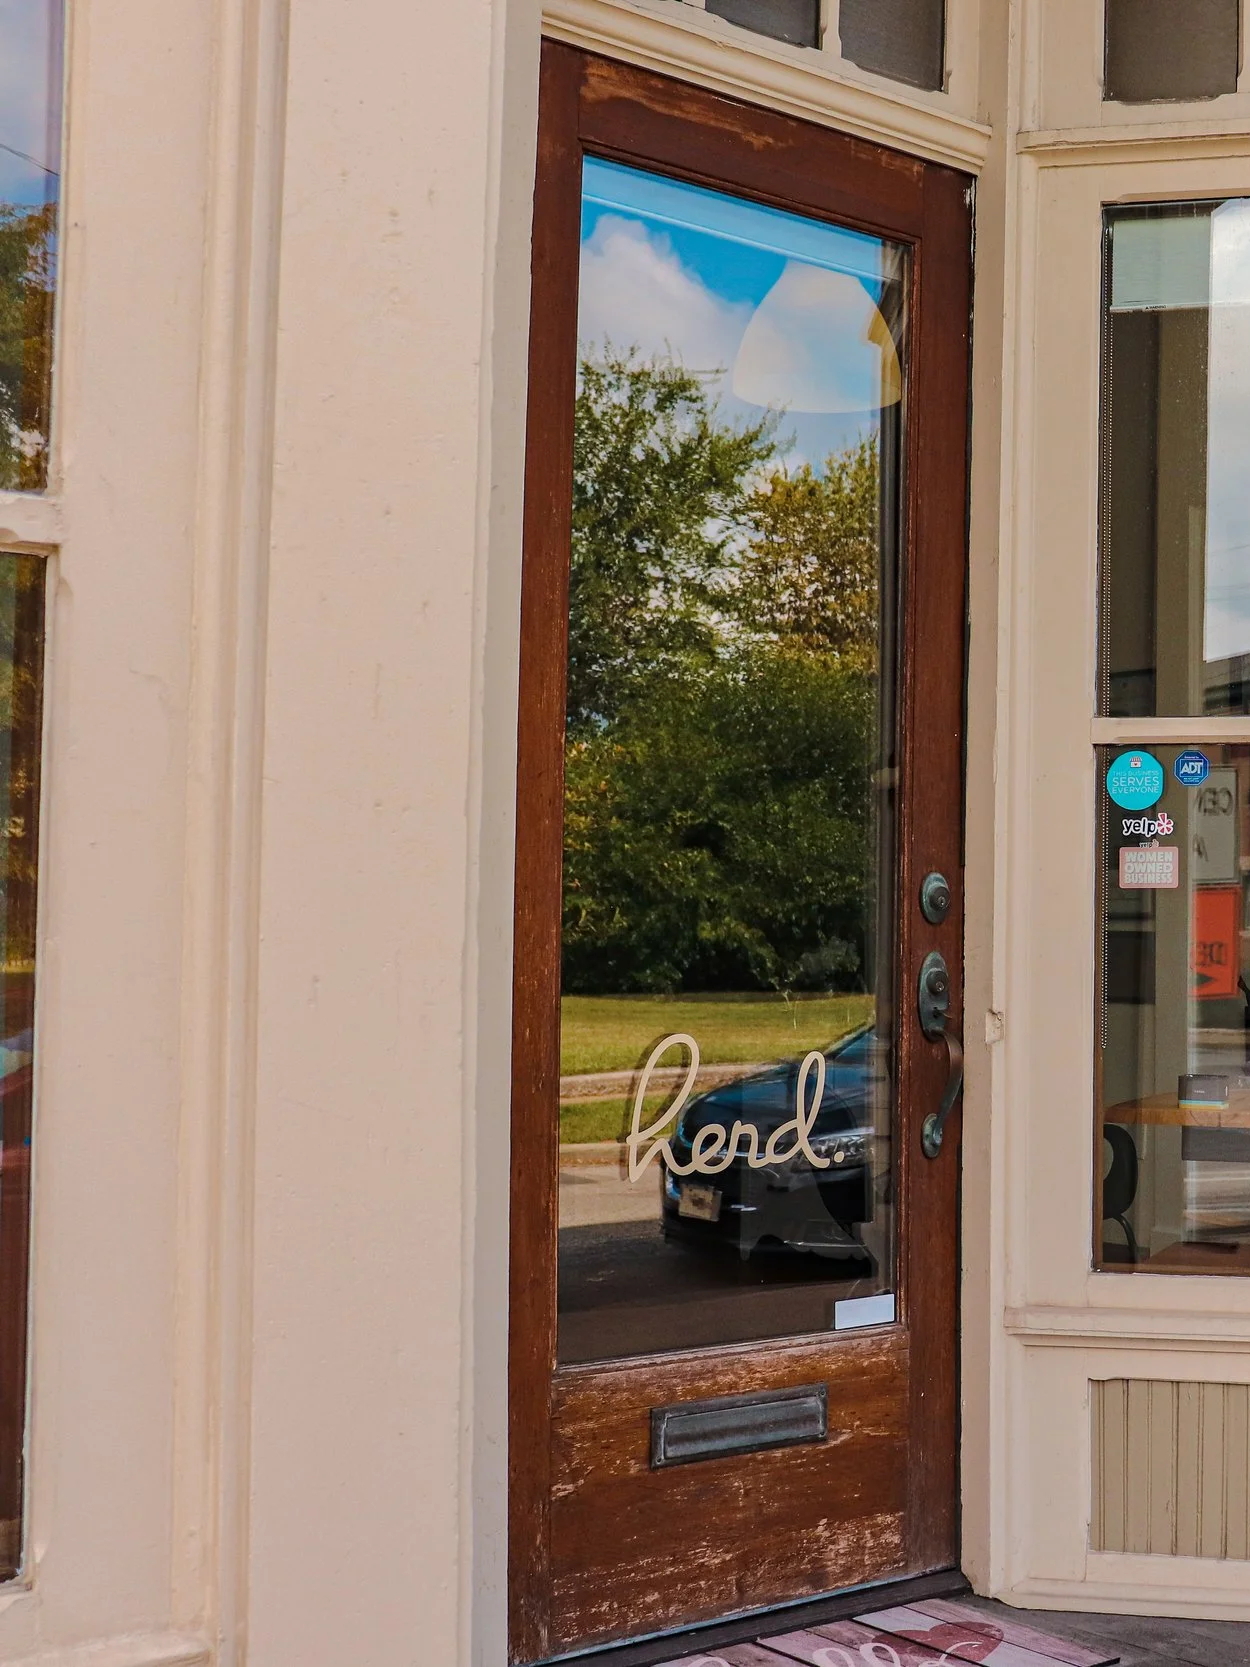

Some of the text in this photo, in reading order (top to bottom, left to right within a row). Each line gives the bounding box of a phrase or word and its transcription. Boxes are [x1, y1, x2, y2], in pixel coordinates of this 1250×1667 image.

[1181, 762, 1203, 774] ADT
[1112, 776, 1160, 787] SERVES
[1111, 786, 1159, 794] EVERYONE
[1122, 817, 1157, 837] yelp
[1125, 851, 1173, 862] WOMEN
[1125, 862, 1173, 873] OWNED
[1124, 873, 1173, 884] BUSINESS
[626, 1033, 845, 1184] herd.
